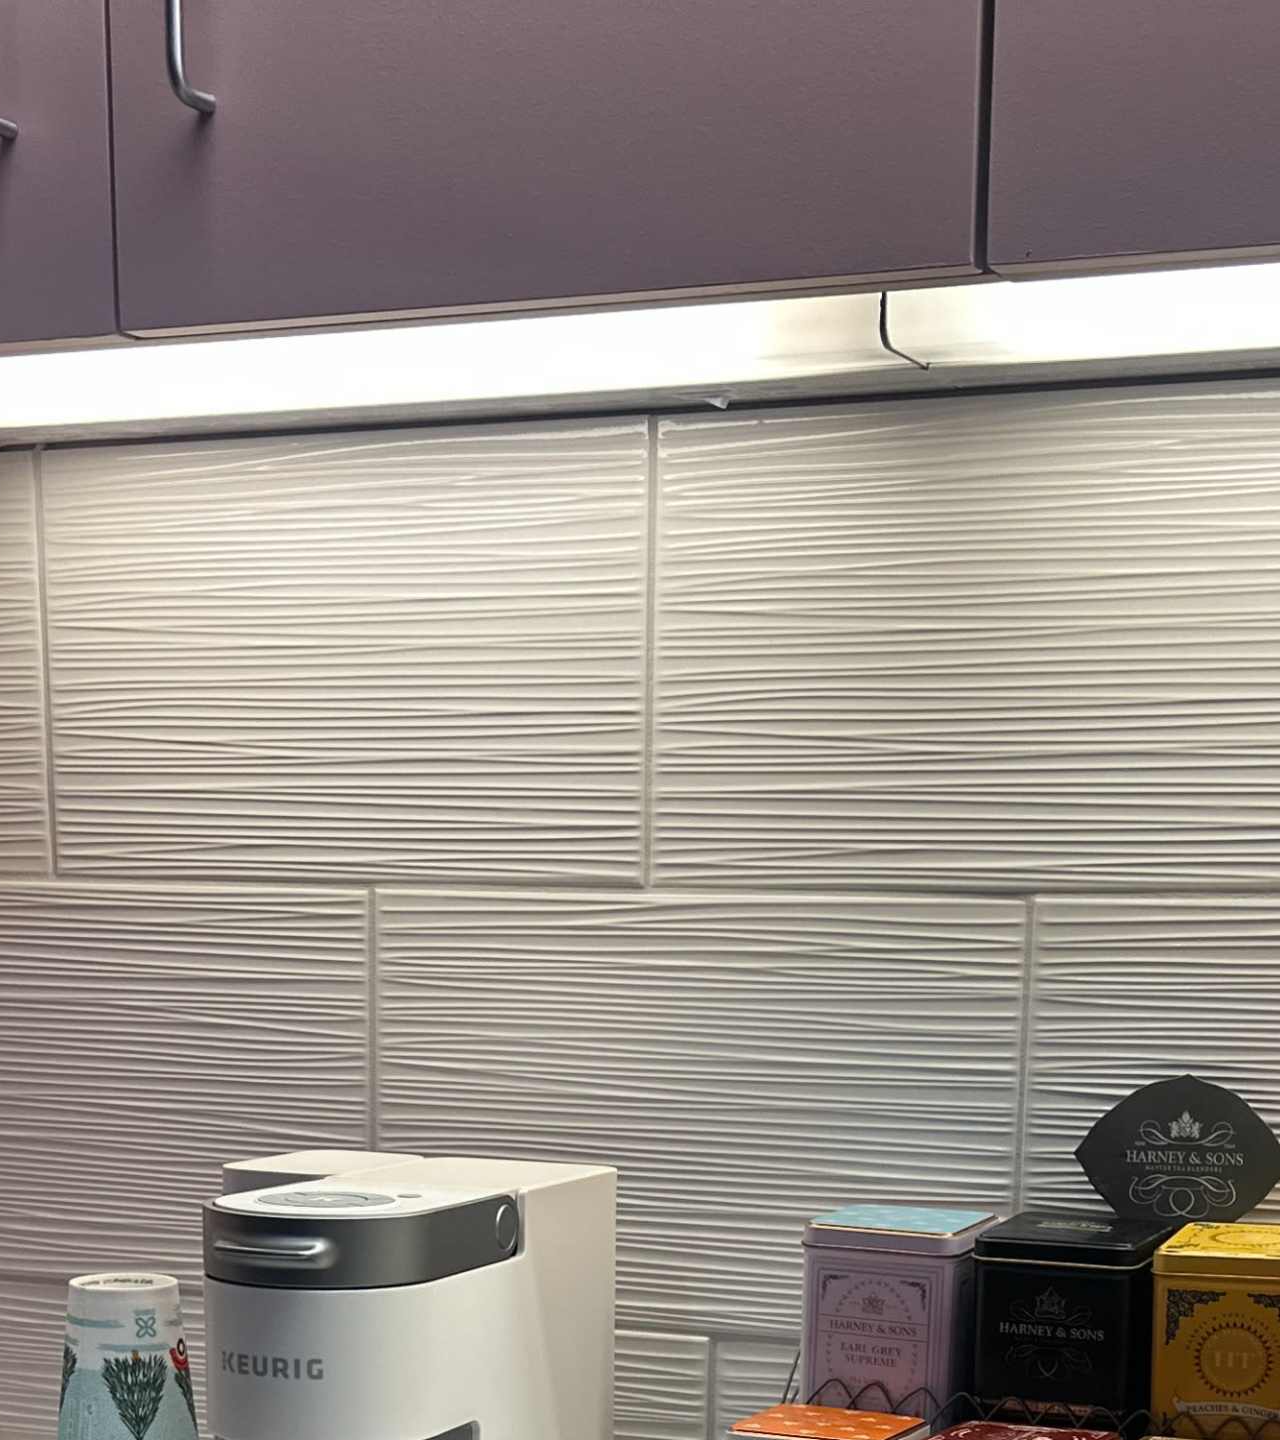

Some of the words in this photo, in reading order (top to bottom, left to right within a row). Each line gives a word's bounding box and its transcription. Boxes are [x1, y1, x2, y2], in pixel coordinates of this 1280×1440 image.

[1126, 1150, 1186, 1164] HARNEY
[1189, 1152, 1202, 1164] &
[1206, 1152, 1244, 1166] SONS
[830, 1319, 875, 1332] HARNEY
[876, 1325, 886, 1334] &
[888, 1325, 917, 1338] SONS
[999, 1321, 1053, 1338] HARNEY
[1056, 1326, 1066, 1339] &
[1070, 1327, 1105, 1341] SONS
[221, 1350, 324, 1380] KEURIG
[845, 1353, 897, 1368] SUPREME
[1186, 1403, 1230, 1414] PEACHES
[1231, 1405, 1239, 1414] &
[1241, 1406, 1279, 1419] GINGER
